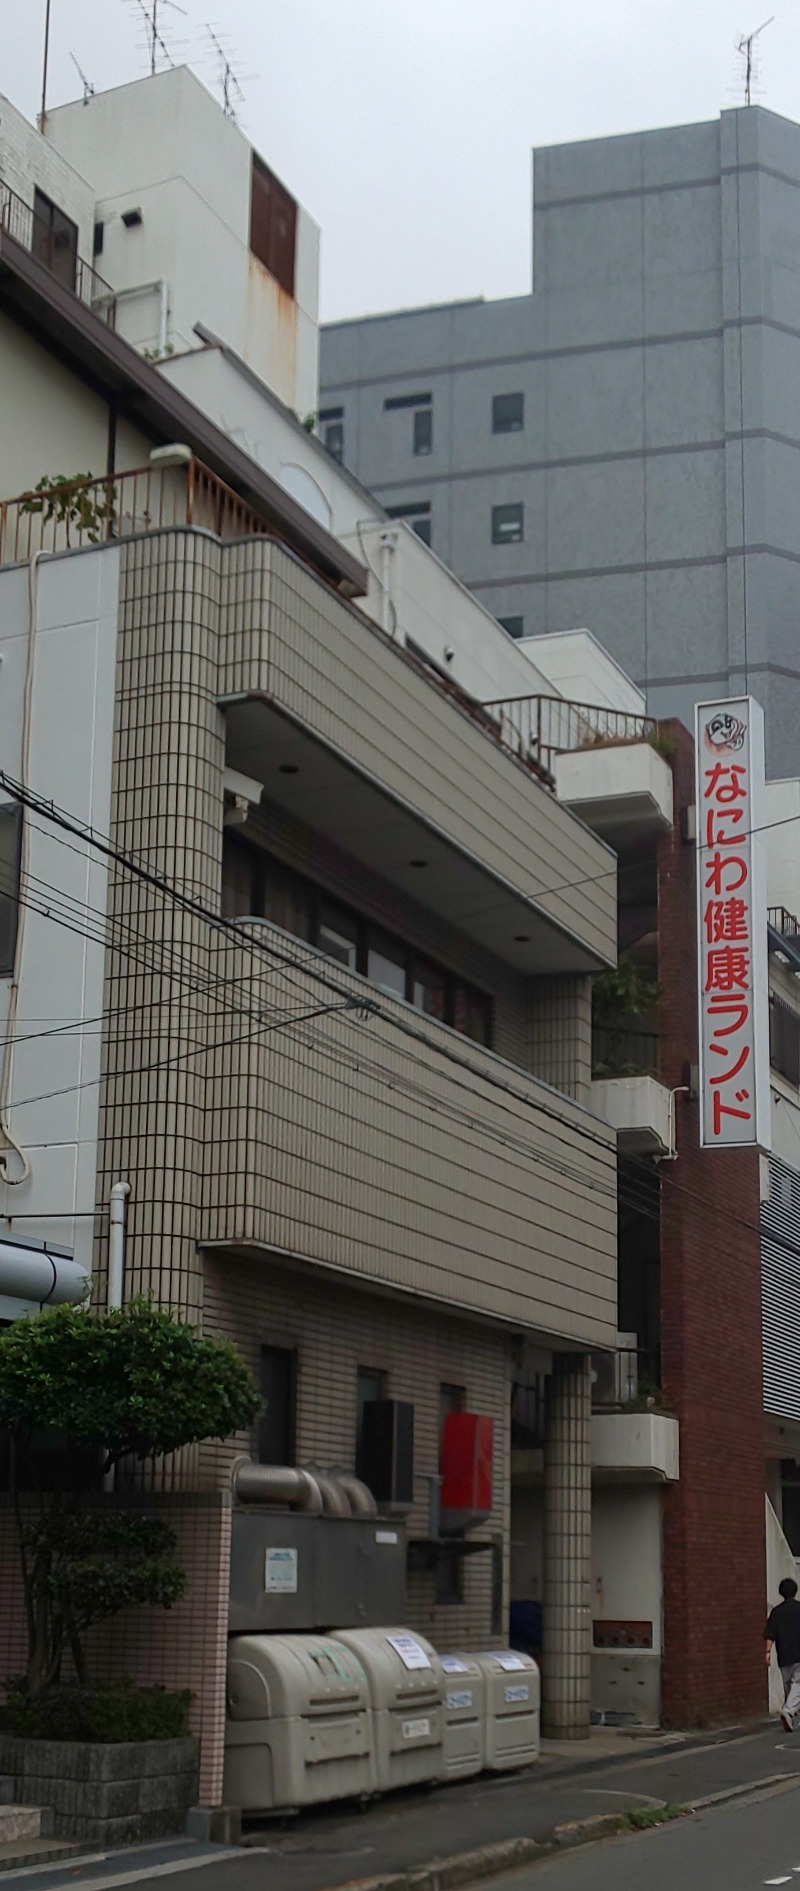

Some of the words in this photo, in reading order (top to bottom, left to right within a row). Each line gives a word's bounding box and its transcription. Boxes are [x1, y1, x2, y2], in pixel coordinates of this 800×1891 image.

[703, 762, 751, 1136] なにわ健康ランド
